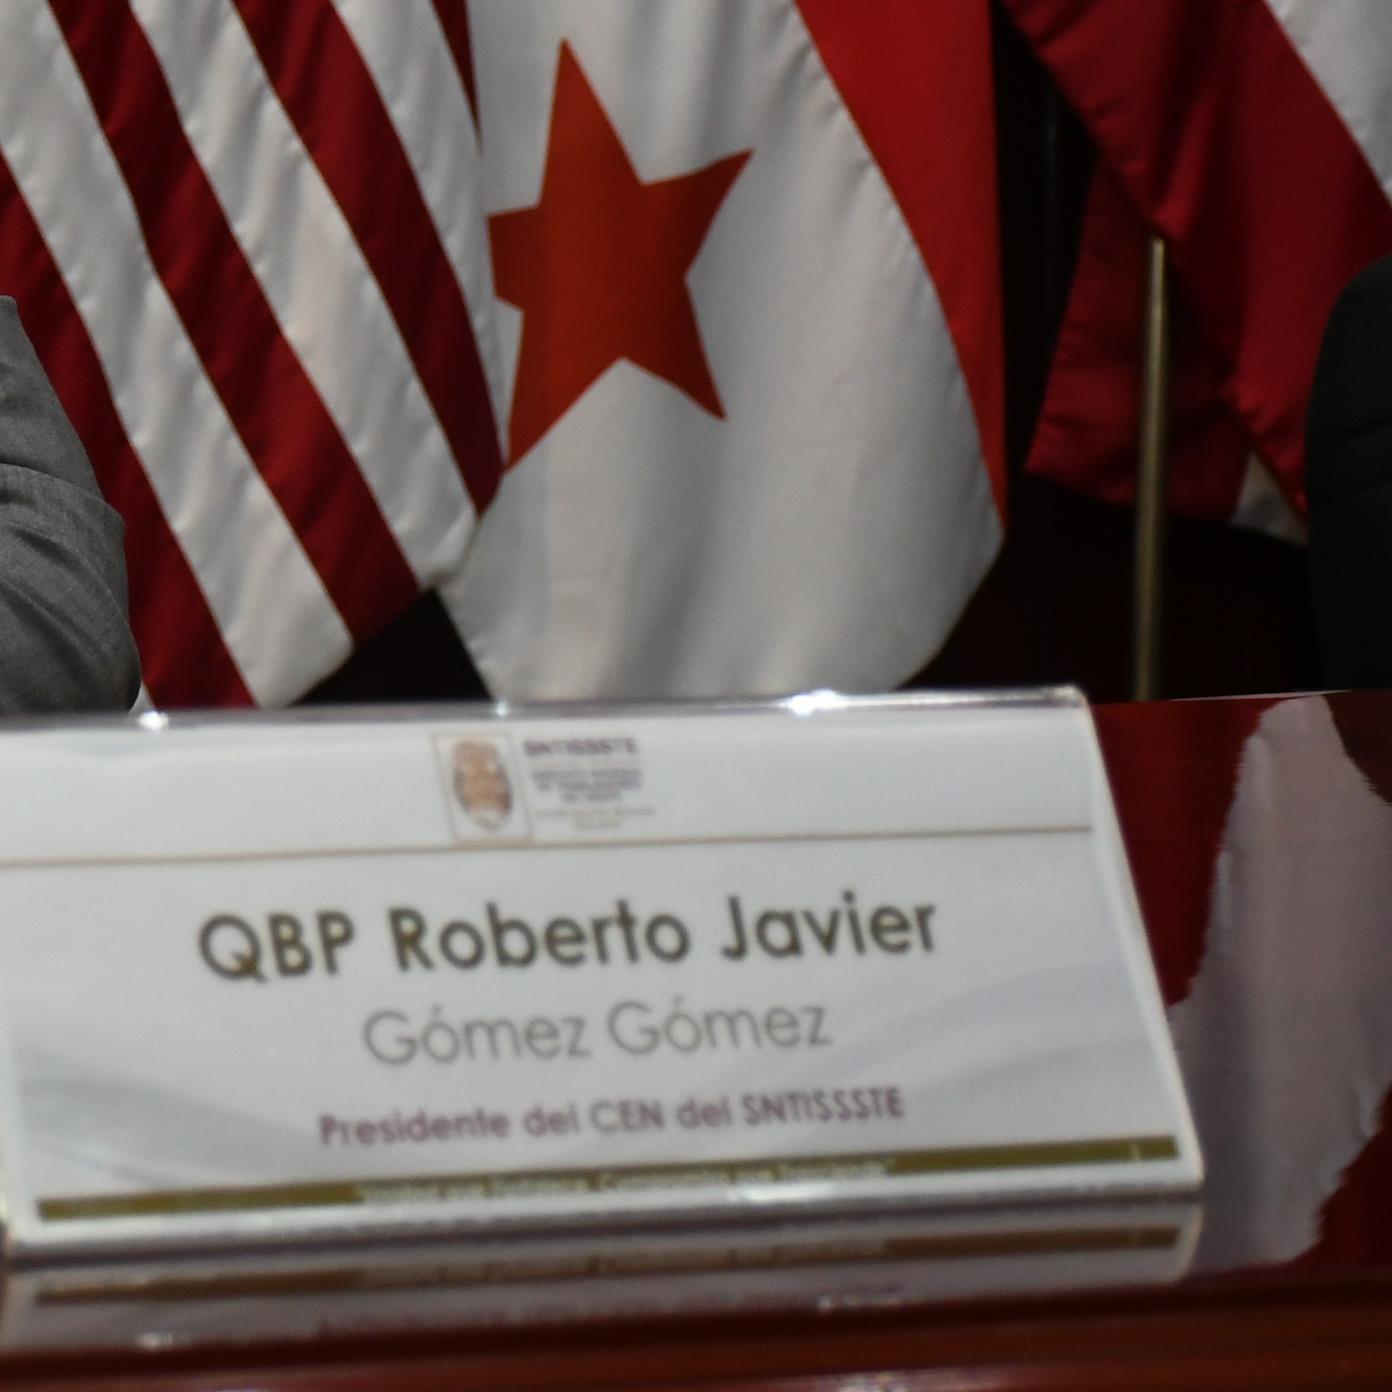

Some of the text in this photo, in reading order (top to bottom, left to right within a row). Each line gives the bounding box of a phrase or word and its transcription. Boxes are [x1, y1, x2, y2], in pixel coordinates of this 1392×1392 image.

[198, 888, 935, 984] QBP Roberto Javier
[362, 994, 833, 1066] Gómez Gómez
[319, 1085, 904, 1146] Presidente del CEN del SNTISSSTE
